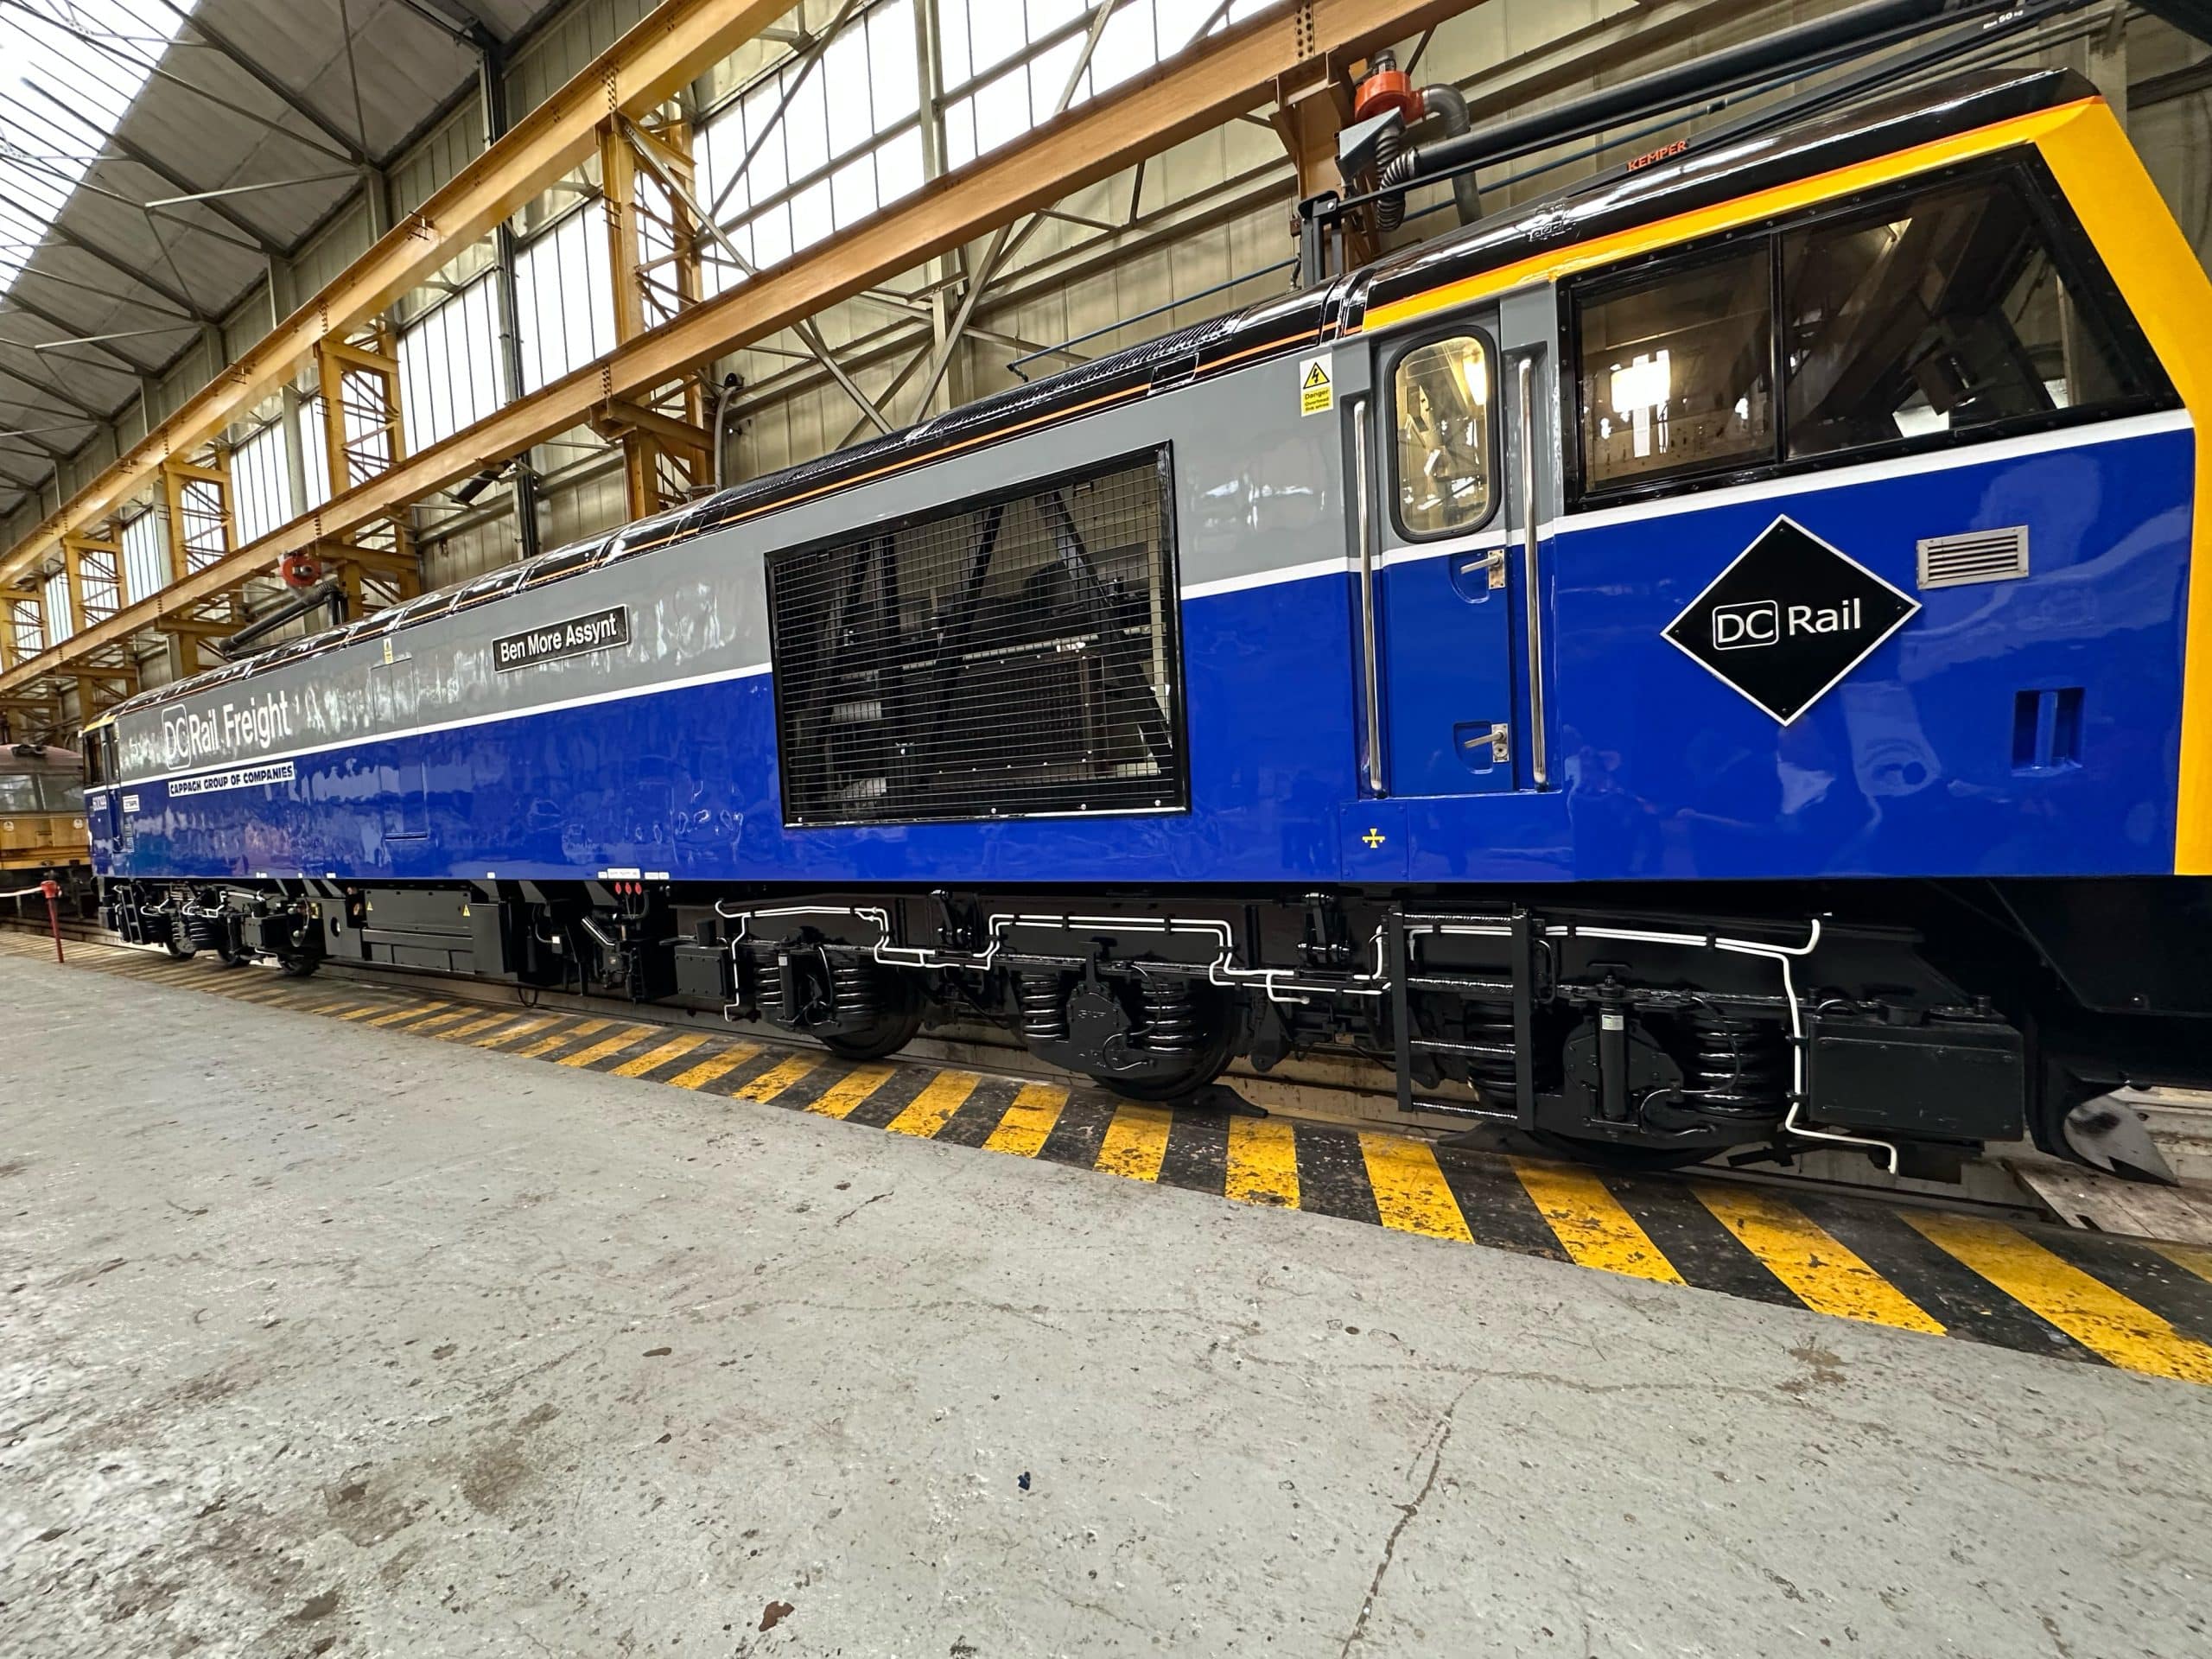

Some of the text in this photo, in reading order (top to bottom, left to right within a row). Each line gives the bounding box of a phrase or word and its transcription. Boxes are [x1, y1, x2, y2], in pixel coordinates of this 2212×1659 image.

[1627, 140, 1688, 172] KEMPER
[1305, 389, 1329, 400] Danger
[500, 613, 617, 662] Ben More Assynt
[1716, 598, 1860, 643] DC Rail
[164, 690, 292, 760] DC Rail Freight
[170, 765, 293, 795] CAPPAGH GROUP OF COMPANIES
